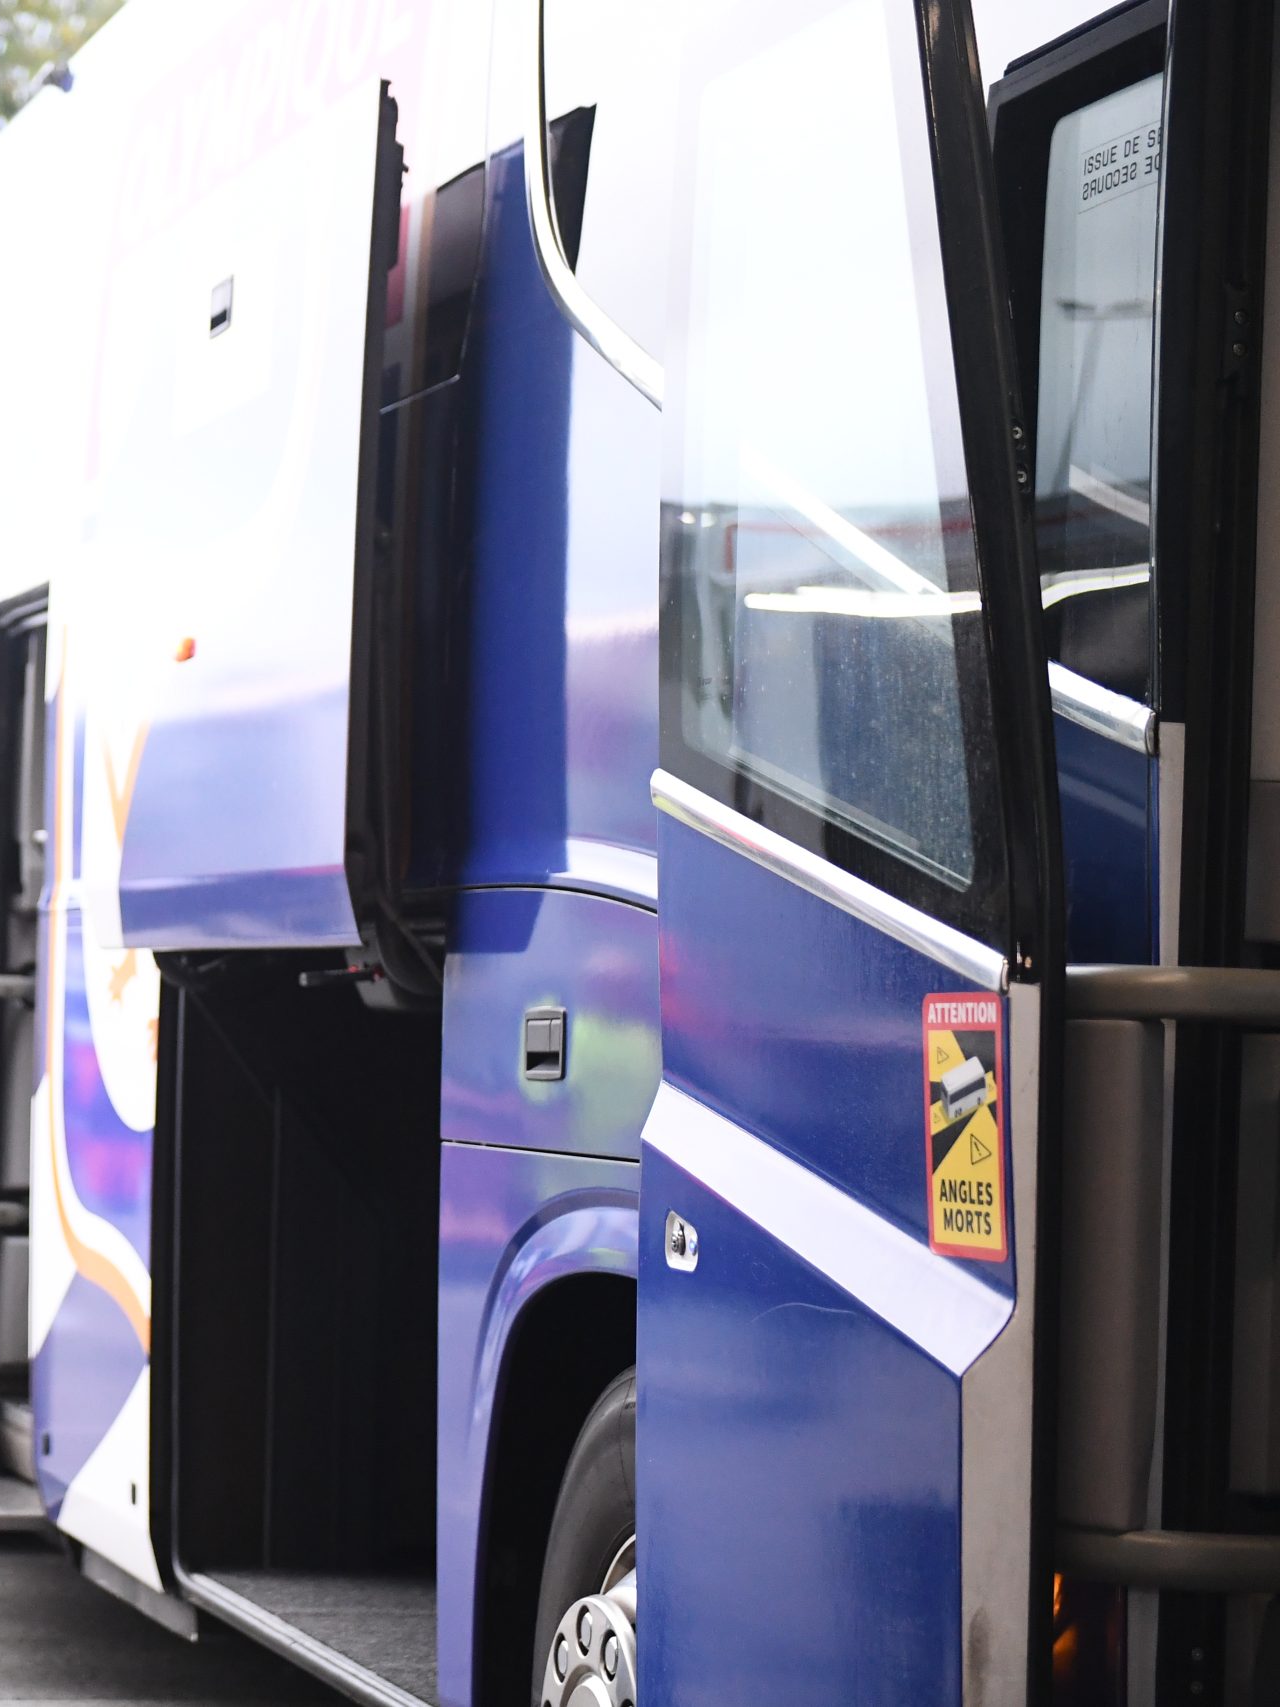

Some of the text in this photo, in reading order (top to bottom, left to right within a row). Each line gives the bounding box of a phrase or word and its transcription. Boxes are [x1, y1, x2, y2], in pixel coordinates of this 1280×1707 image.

[1083, 145, 1118, 176] ISSUE
[1124, 136, 1140, 158] DE
[927, 1001, 997, 1024] ATTENTION
[939, 1178, 993, 1206] ANGLES
[943, 1207, 992, 1235] MORTS
